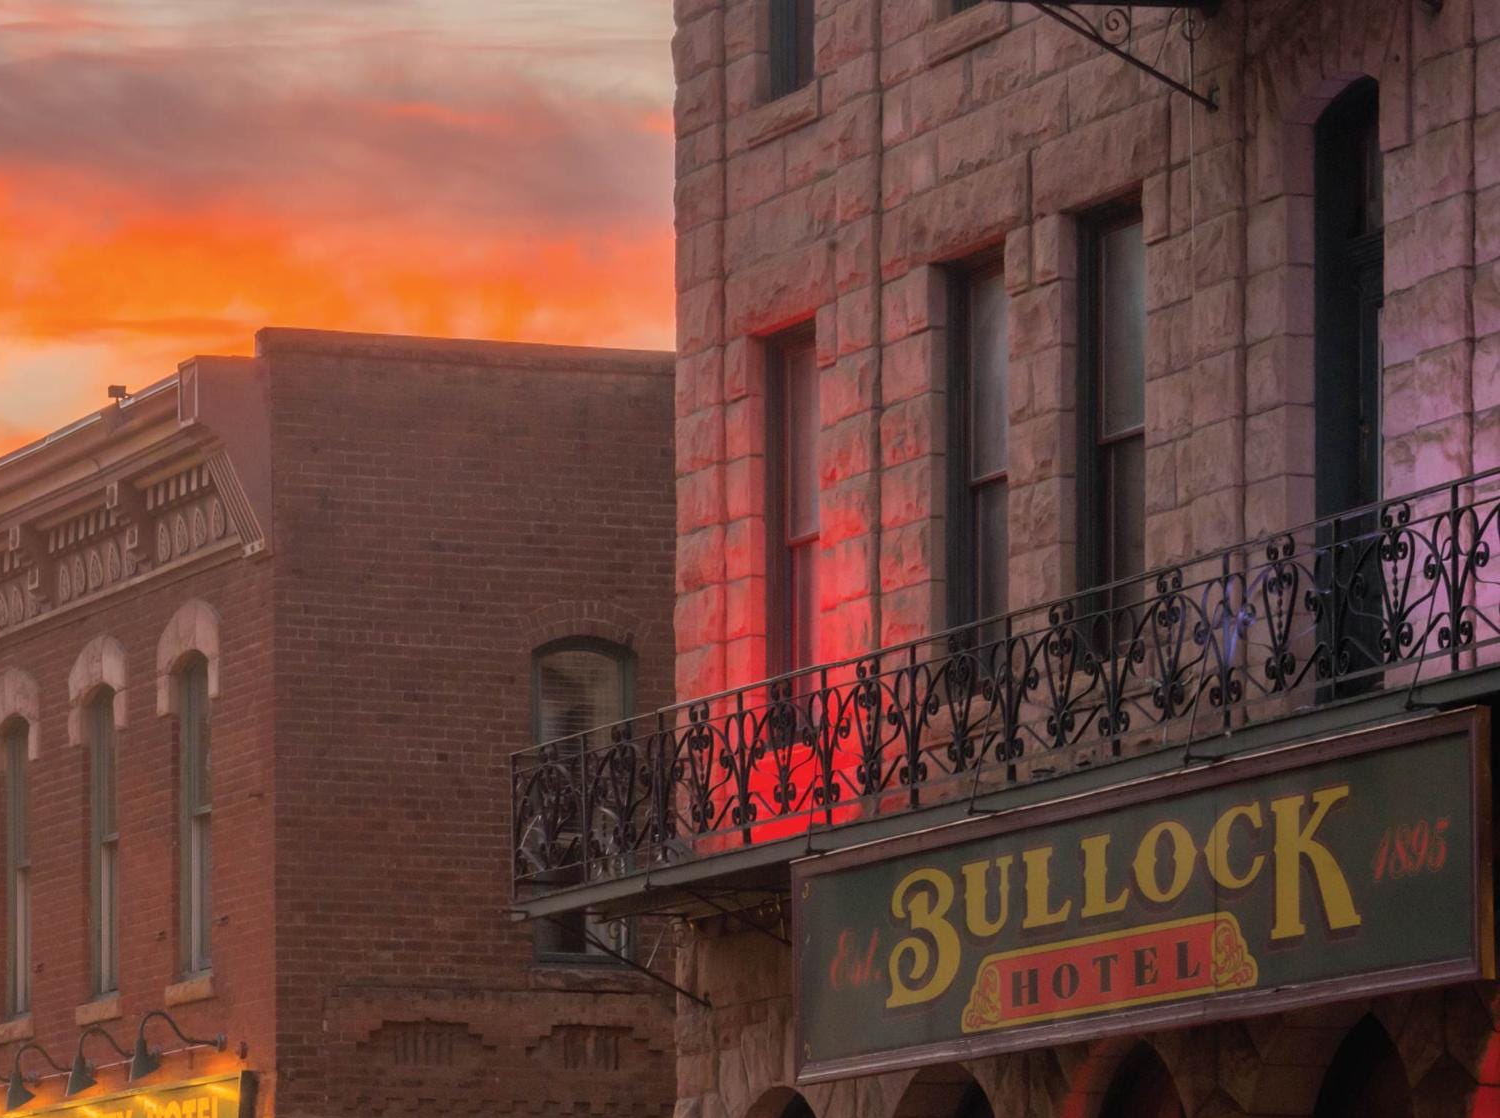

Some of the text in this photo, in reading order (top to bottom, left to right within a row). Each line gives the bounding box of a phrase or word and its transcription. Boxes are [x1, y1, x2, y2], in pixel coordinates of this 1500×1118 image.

[1371, 815, 1451, 882] 1895
[886, 785, 1361, 1008] BULLOCK
[1010, 940, 1201, 1009] HOTEL
